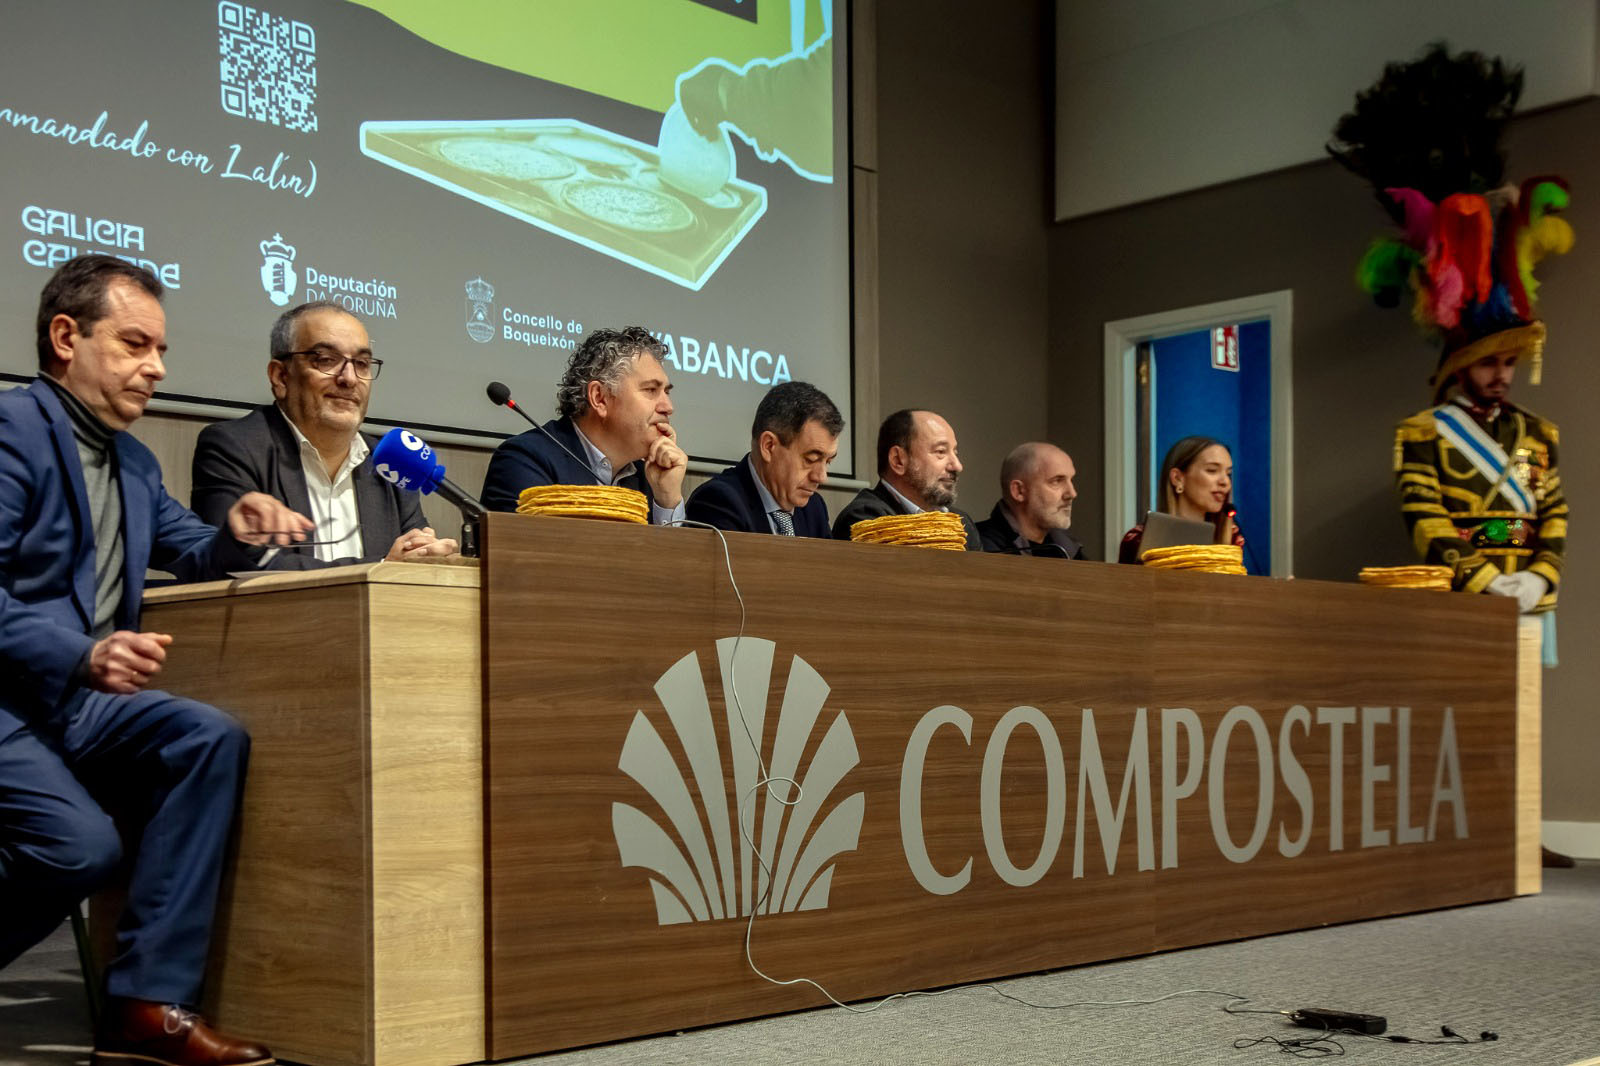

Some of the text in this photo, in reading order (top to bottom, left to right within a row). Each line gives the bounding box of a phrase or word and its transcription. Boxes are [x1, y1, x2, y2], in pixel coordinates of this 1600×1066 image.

[166, 148, 214, 174] con
[220, 143, 317, 197] Lalín)
[21, 205, 145, 251] GALICIA
[306, 266, 397, 299] Deputación
[503, 307, 583, 334] Concello de
[503, 325, 576, 350] Boqueixón
[899, 704, 1469, 896] COMPOSTELA
